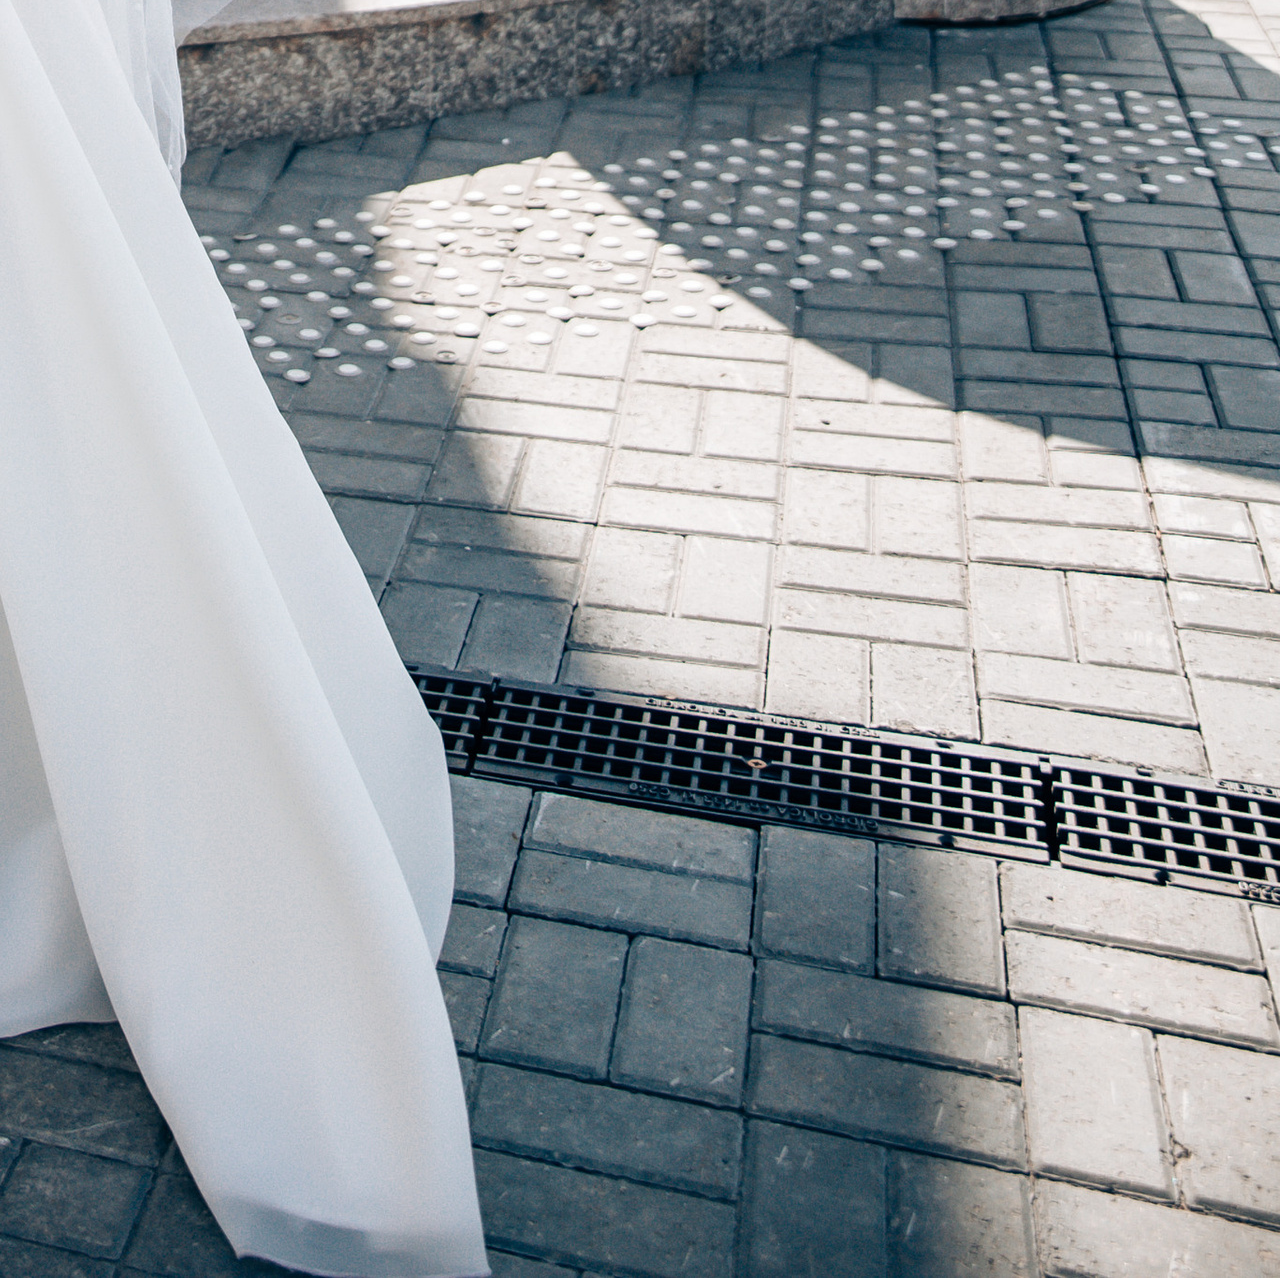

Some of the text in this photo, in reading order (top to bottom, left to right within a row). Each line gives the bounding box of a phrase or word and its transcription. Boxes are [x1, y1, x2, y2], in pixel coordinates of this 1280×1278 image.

[645, 697, 738, 718] GIDROLICA
[628, 782, 671, 796] C250
[776, 805, 879, 831] GIDROLICA
